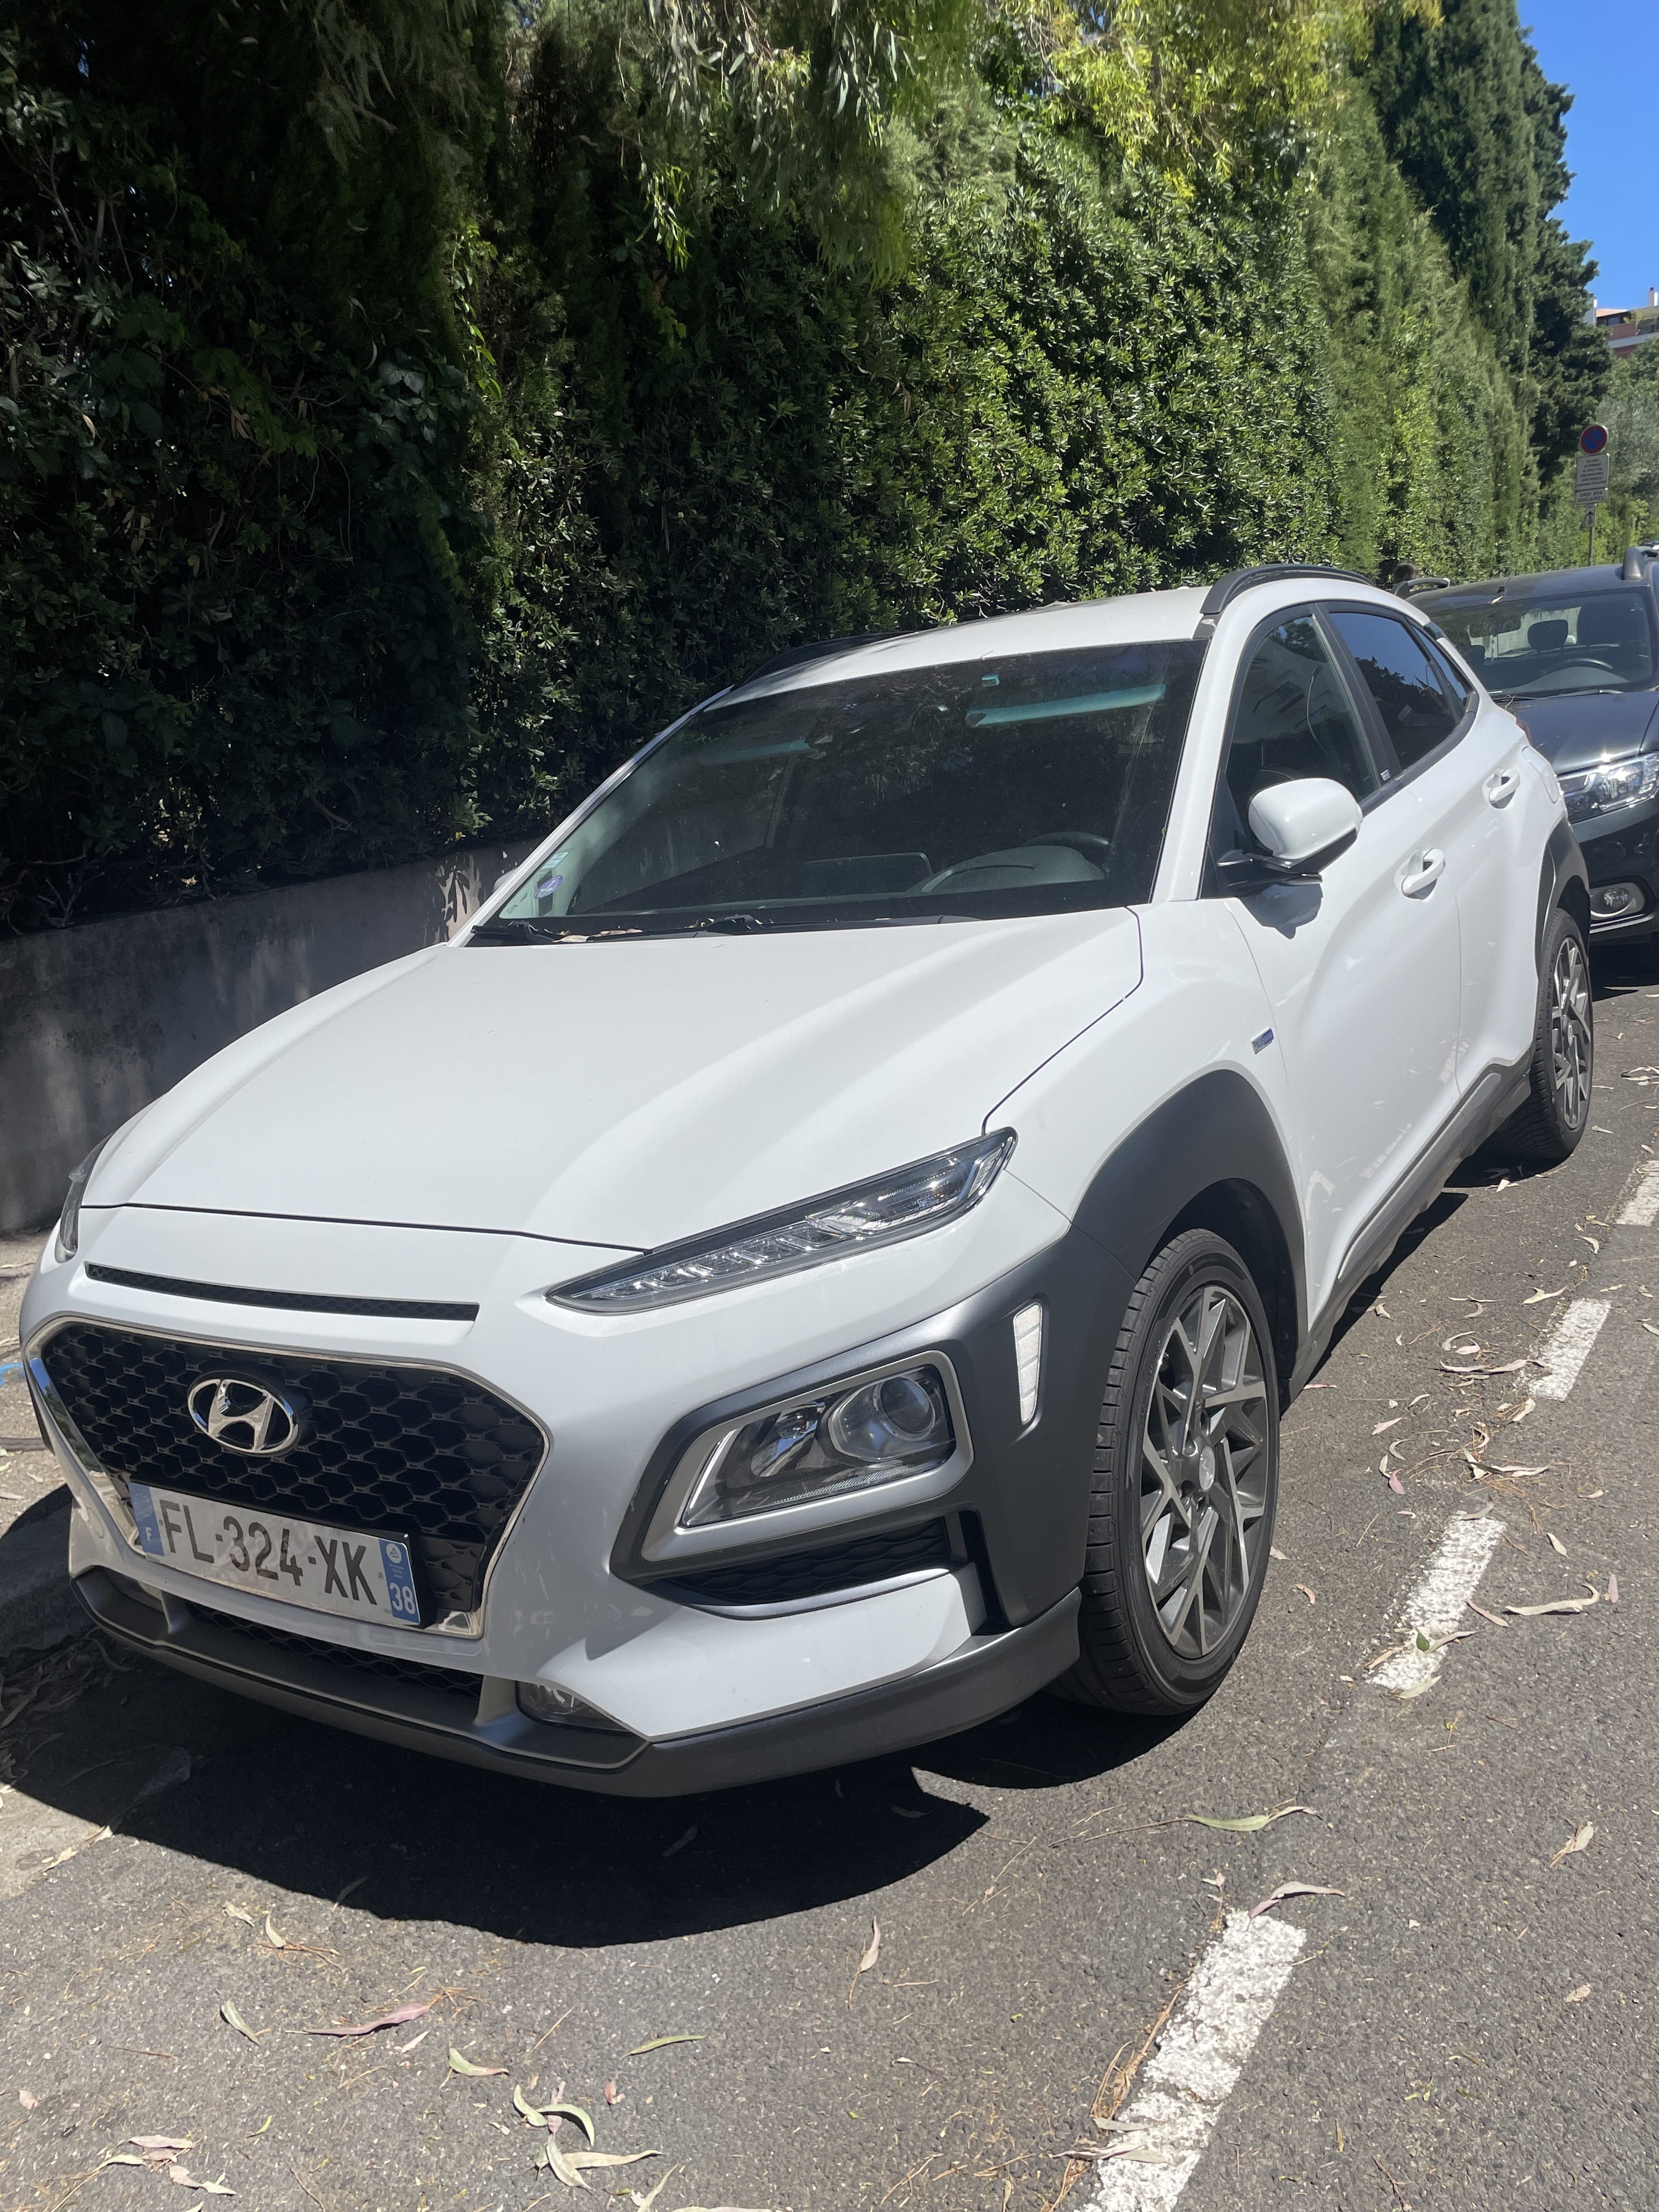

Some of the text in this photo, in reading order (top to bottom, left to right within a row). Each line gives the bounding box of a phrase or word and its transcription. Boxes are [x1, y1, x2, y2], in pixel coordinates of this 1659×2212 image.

[145, 1527, 153, 1542] F
[160, 1499, 377, 1605] FL-324-XK
[390, 1582, 415, 1614] 38
